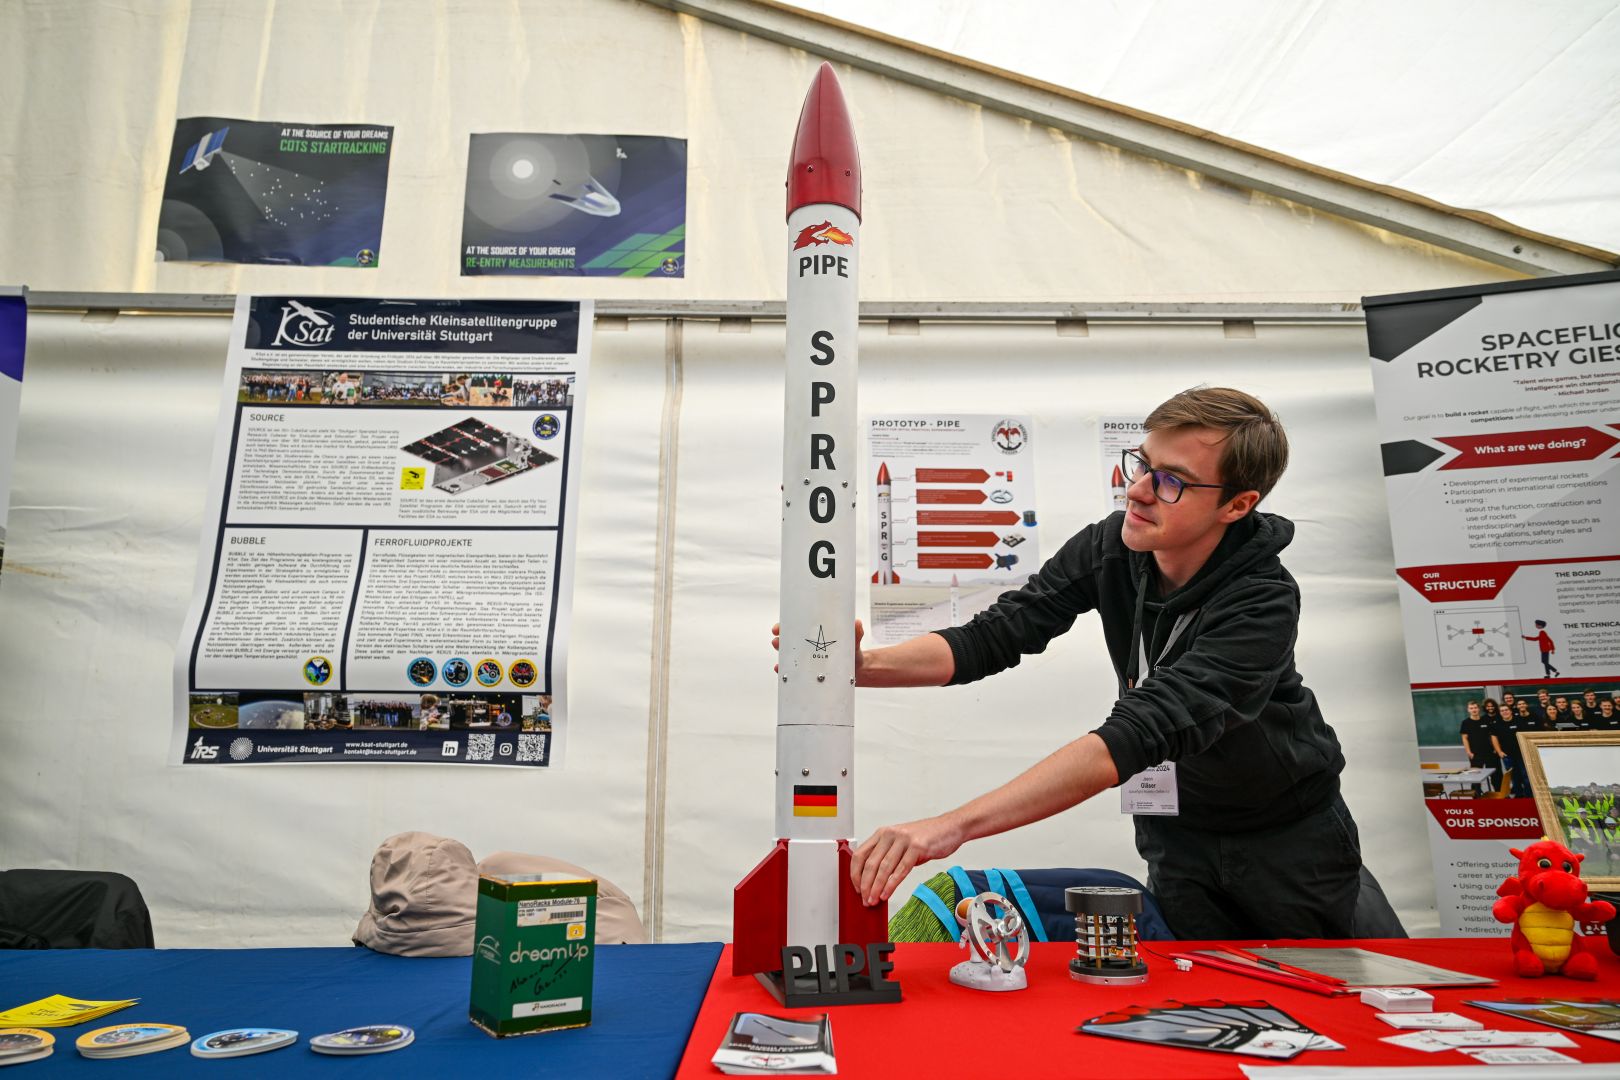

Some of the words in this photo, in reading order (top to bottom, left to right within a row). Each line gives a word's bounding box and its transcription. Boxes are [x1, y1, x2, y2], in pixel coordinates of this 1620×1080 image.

[281, 128, 289, 137] AT
[292, 129, 304, 137] THE
[306, 129, 331, 139] SOURCE
[333, 130, 342, 139] OF
[343, 130, 360, 139] YOUR
[361, 130, 389, 139] DREAMS
[280, 139, 308, 152] COTS
[311, 141, 386, 154] STARTRACKING
[466, 246, 474, 254] AT
[477, 246, 489, 255] THE
[491, 246, 517, 255] SOURCE
[519, 247, 527, 255] OF
[529, 247, 547, 255] YOUR
[548, 247, 576, 256] DREAMS
[466, 257, 506, 267] RE-ENTRY
[508, 258, 575, 268] MEASUREMENTS
[799, 254, 848, 278] PIPE
[349, 314, 426, 326] Studentische
[430, 315, 557, 330] Kleinsatellitengruppe
[348, 329, 368, 340] der
[372, 329, 437, 341] Universität
[440, 330, 493, 344] Stuttgart
[1417, 350, 1560, 378] ROCKETRY
[1525, 384, 1563, 392] intelligence
[250, 413, 285, 422] SOURCE
[1470, 415, 1513, 423] competitions
[937, 420, 960, 428] PIPE
[1474, 445, 1505, 455] What
[1507, 444, 1526, 452] are
[1547, 438, 1586, 449] doing?
[808, 330, 836, 578] SPROG
[1449, 479, 1498, 487] Development
[1509, 474, 1559, 484] experimental
[1450, 487, 1496, 495] Participation
[1507, 483, 1555, 492] international
[1556, 480, 1608, 488] competitions
[1502, 503, 1535, 511] function,
[1537, 500, 1584, 508] construction
[1467, 521, 1525, 530] interdisciplinary
[1528, 519, 1569, 527] knowledge
[230, 536, 266, 545] BUBBLE
[1488, 531, 1531, 539] regulations,
[375, 538, 473, 547] FERROFLUIDPROJEKTE
[1469, 541, 1502, 549] scientific
[1503, 537, 1564, 547] communication
[1424, 579, 1496, 591] STRUCTURE
[257, 745, 298, 753] Universität
[300, 745, 333, 755] Stuttgart
[345, 741, 408, 749] www.ksat-stuttgart.de
[344, 748, 417, 756] kontakt@ksat-stuttgart.de
[1446, 818, 1475, 828] OUR
[1478, 817, 1539, 828] SPONSOR
[1456, 861, 1490, 869] Offering
[510, 941, 589, 963] dreamUp
[782, 943, 901, 996] PIPE
